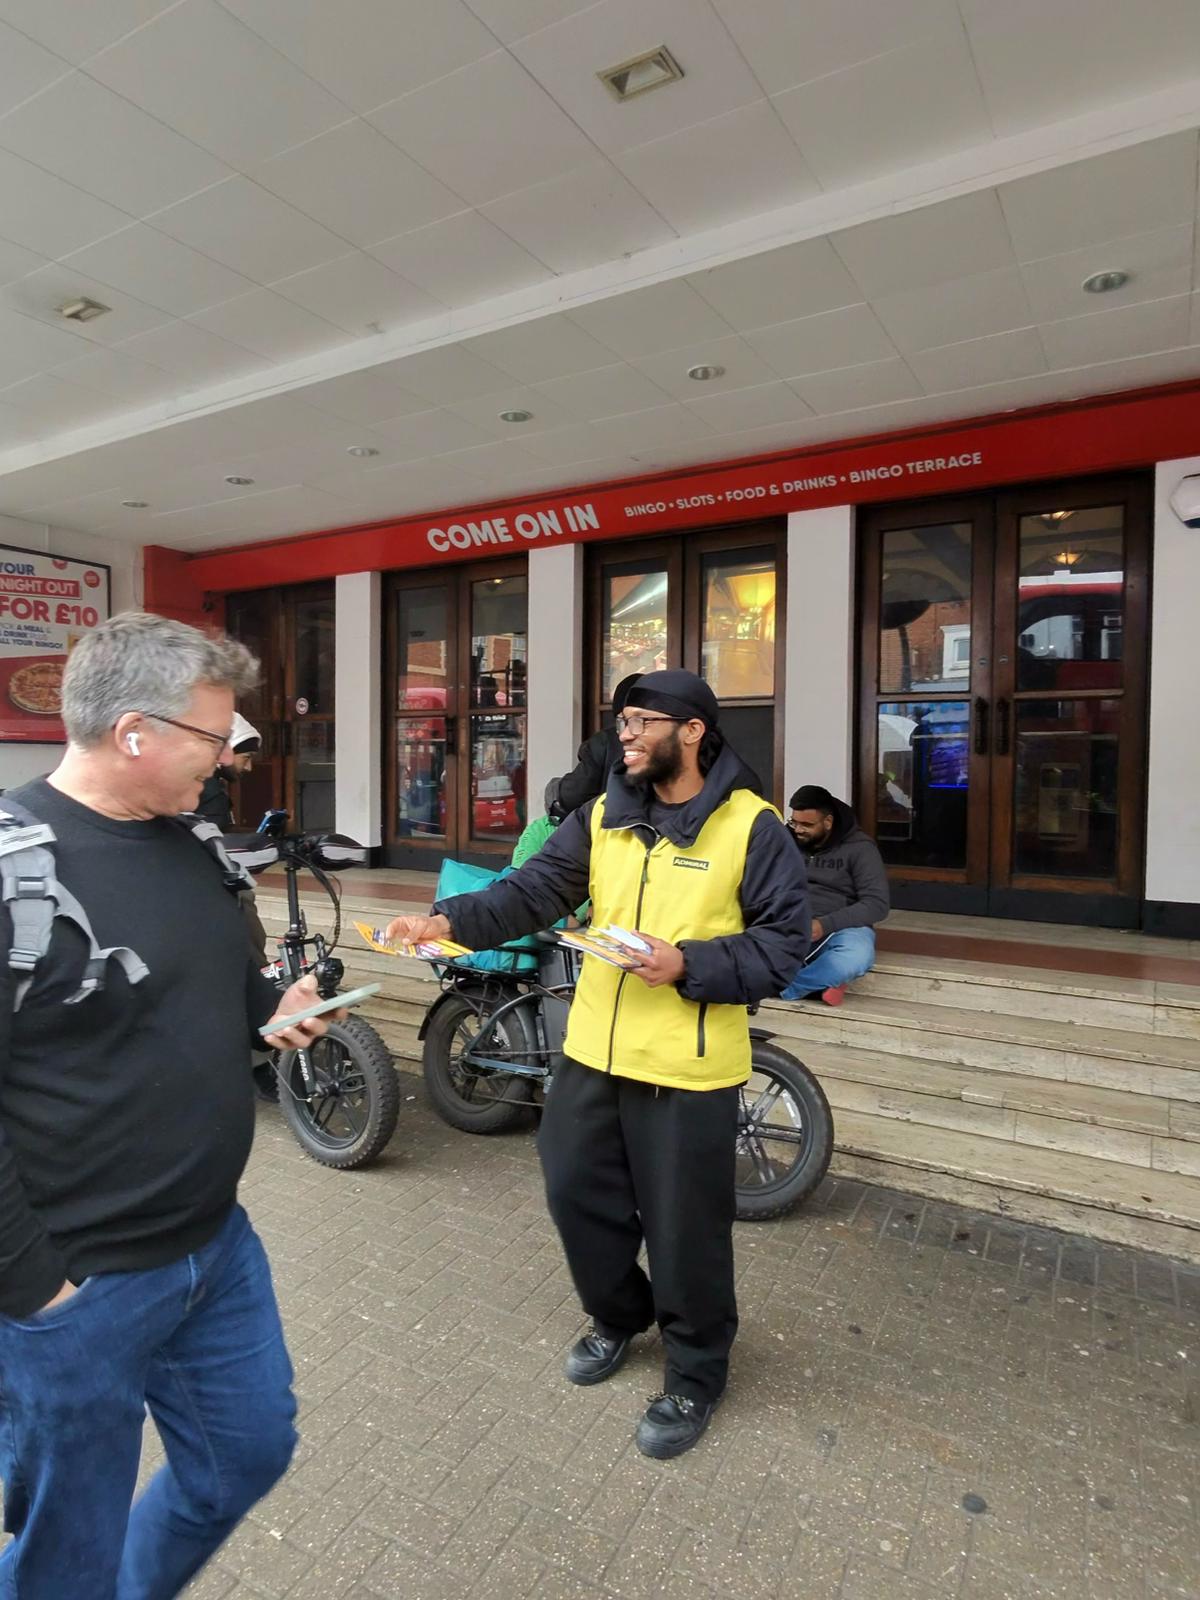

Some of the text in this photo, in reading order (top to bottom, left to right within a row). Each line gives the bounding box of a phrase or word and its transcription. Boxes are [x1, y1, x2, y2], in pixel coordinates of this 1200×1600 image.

[624, 452, 982, 517] BINGO SLOTS FOOD & DRINKS BINGO TERRACE
[427, 503, 600, 552] COME ON IN
[0, 577, 76, 595] NIGHT OUT
[0, 596, 98, 628] FOR £10
[674, 858, 708, 870] ADMIRAL
